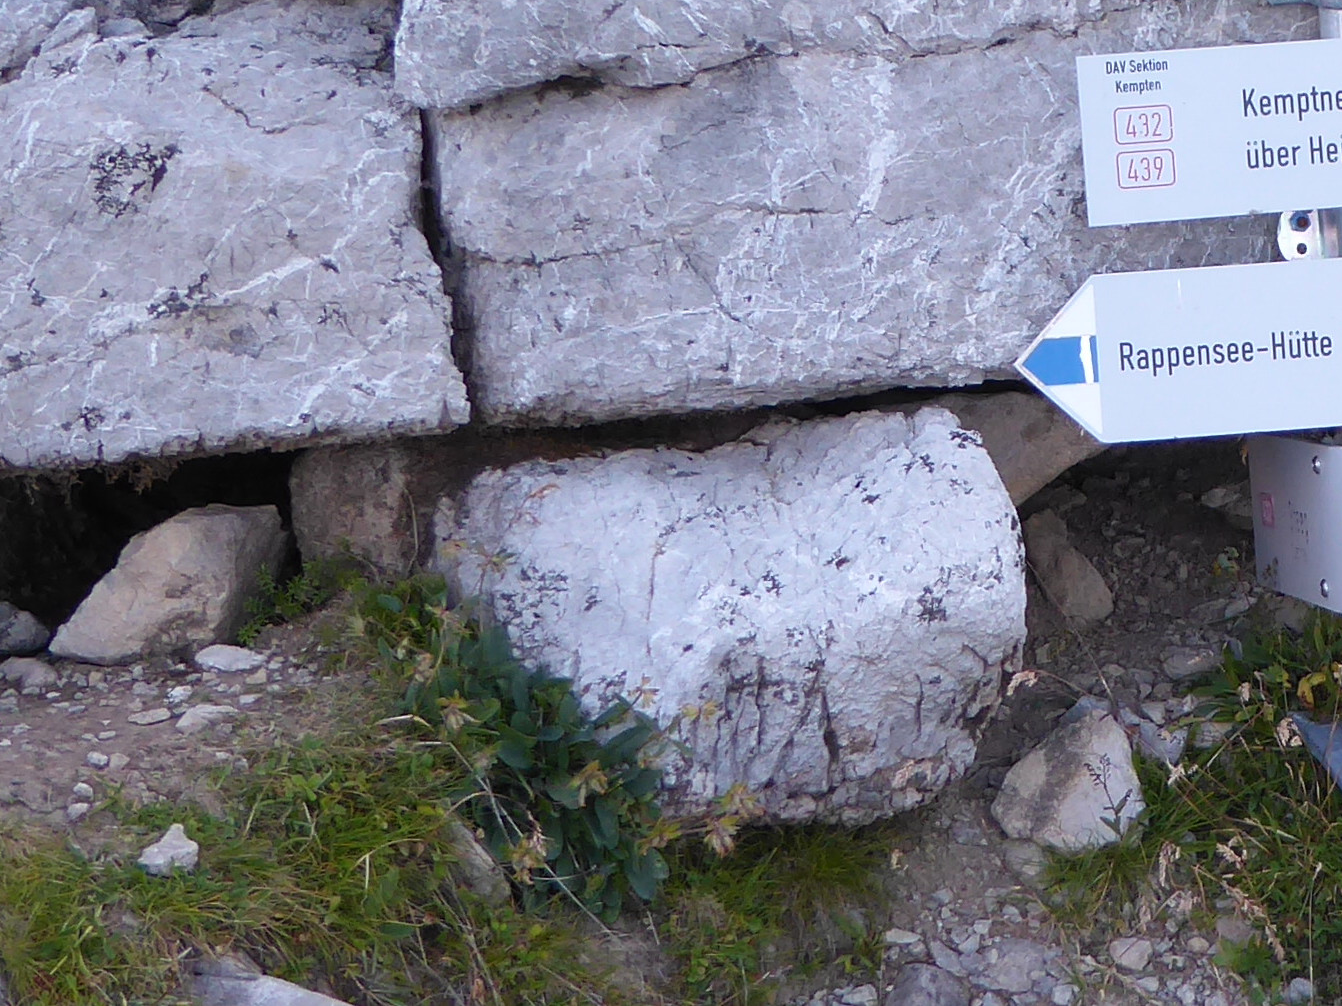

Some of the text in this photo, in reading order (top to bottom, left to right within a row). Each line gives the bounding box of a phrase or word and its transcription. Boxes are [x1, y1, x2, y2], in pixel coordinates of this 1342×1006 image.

[1105, 58, 1169, 75] DAV Sektion
[1115, 79, 1162, 95] Kempten
[1126, 112, 1163, 139] 432
[1246, 140, 1301, 170] über
[1127, 156, 1164, 183] 439
[1119, 330, 1333, 377] Rappensee-Hütte
